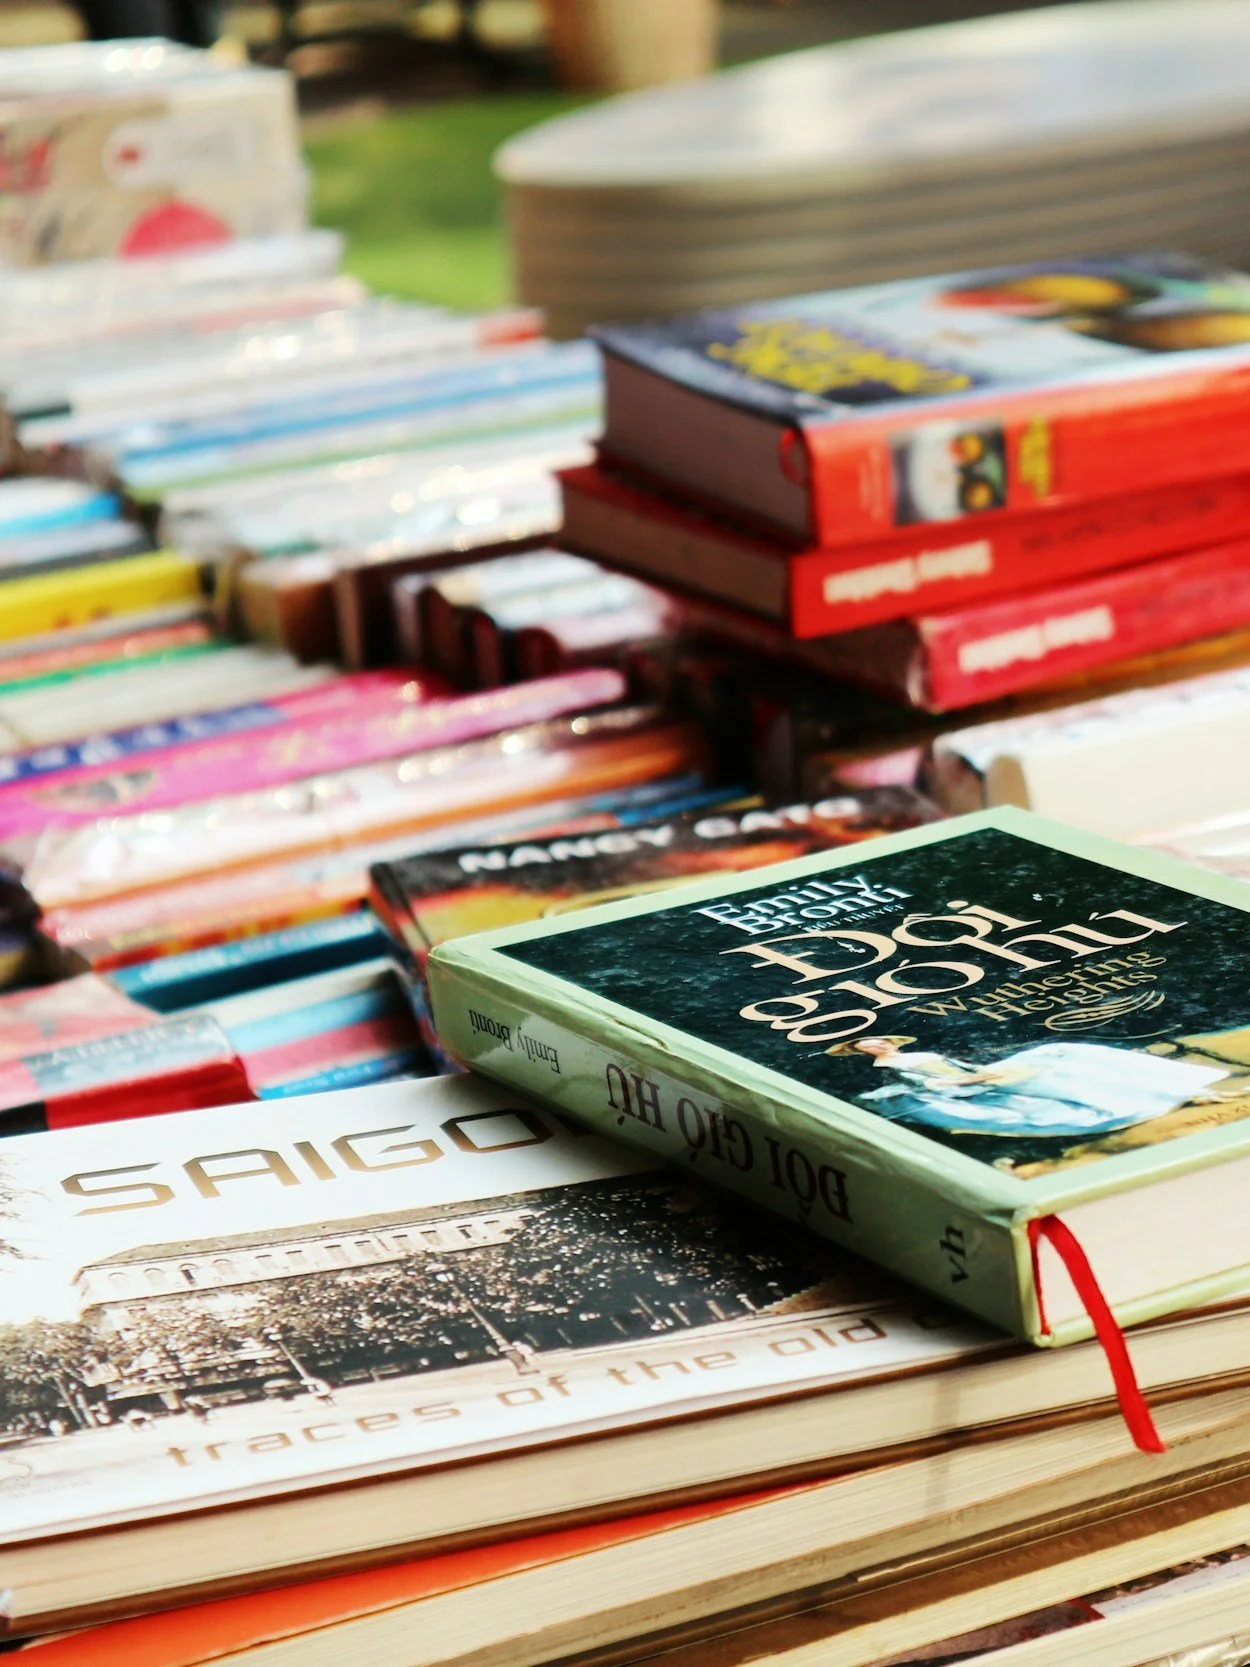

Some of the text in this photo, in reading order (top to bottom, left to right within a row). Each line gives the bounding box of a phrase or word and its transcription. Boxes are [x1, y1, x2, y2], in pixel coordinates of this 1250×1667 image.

[690, 875, 871, 924] Emily
[719, 882, 913, 936] Bronti
[906, 951, 1167, 1017] Wuthering
[972, 969, 1158, 1022] Heights
[517, 1026, 561, 1074] Emily
[165, 1401, 462, 1469] traces
[496, 1373, 570, 1408] of
[606, 1350, 737, 1386] the
[768, 1317, 888, 1359] old
